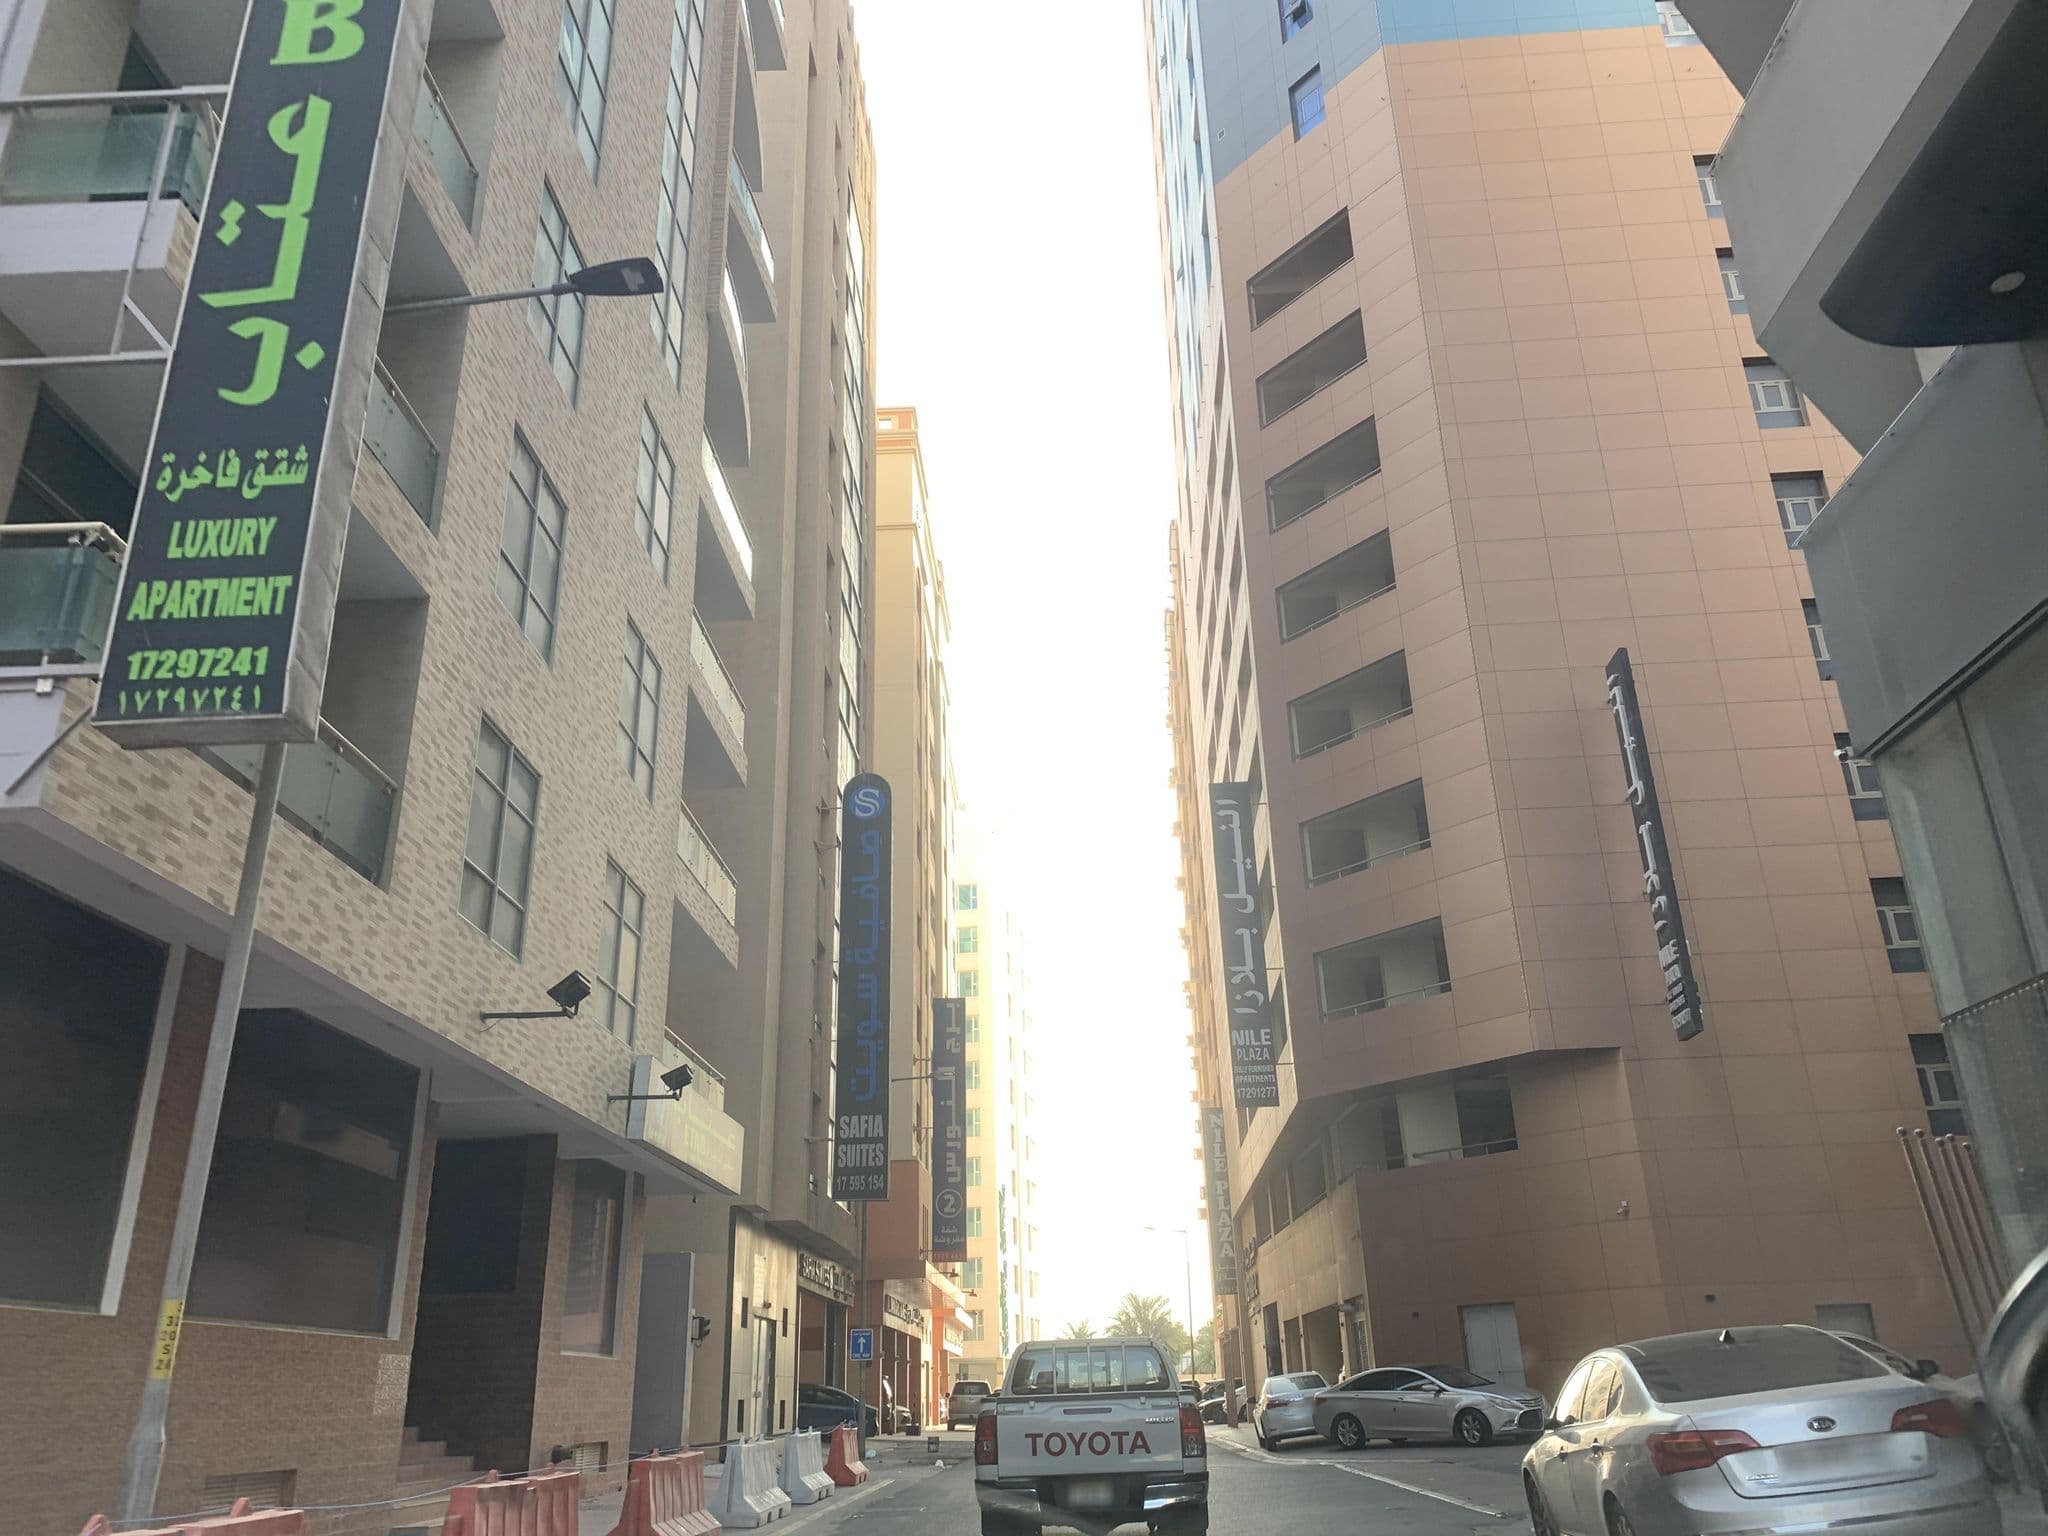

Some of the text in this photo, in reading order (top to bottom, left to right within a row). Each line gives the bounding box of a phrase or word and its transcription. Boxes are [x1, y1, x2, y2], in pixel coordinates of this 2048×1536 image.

[198, 93, 331, 407] عتاب
[155, 443, 310, 502] شقق فاخرة
[167, 516, 277, 559] LUXURY
[128, 574, 293, 621] APARTMENT
[127, 646, 269, 681] 17297241
[1215, 799, 1265, 1015] النيل بلازا
[845, 829, 888, 1103] صافية سويت
[945, 1001, 961, 1054] برج
[1231, 1028, 1272, 1046] NILE
[1236, 1047, 1271, 1061] PLAZA
[1236, 1086, 1277, 1099] 17291277
[838, 1113, 885, 1140] SAFIA
[1208, 1113, 1227, 1172] NILE
[837, 1142, 885, 1168] SUITES
[836, 1174, 885, 1192] 17 595 154
[943, 1193, 956, 1214] 2
[1215, 1180, 1236, 1257] PLAZA
[1024, 1430, 1152, 1457] TOYOTA
